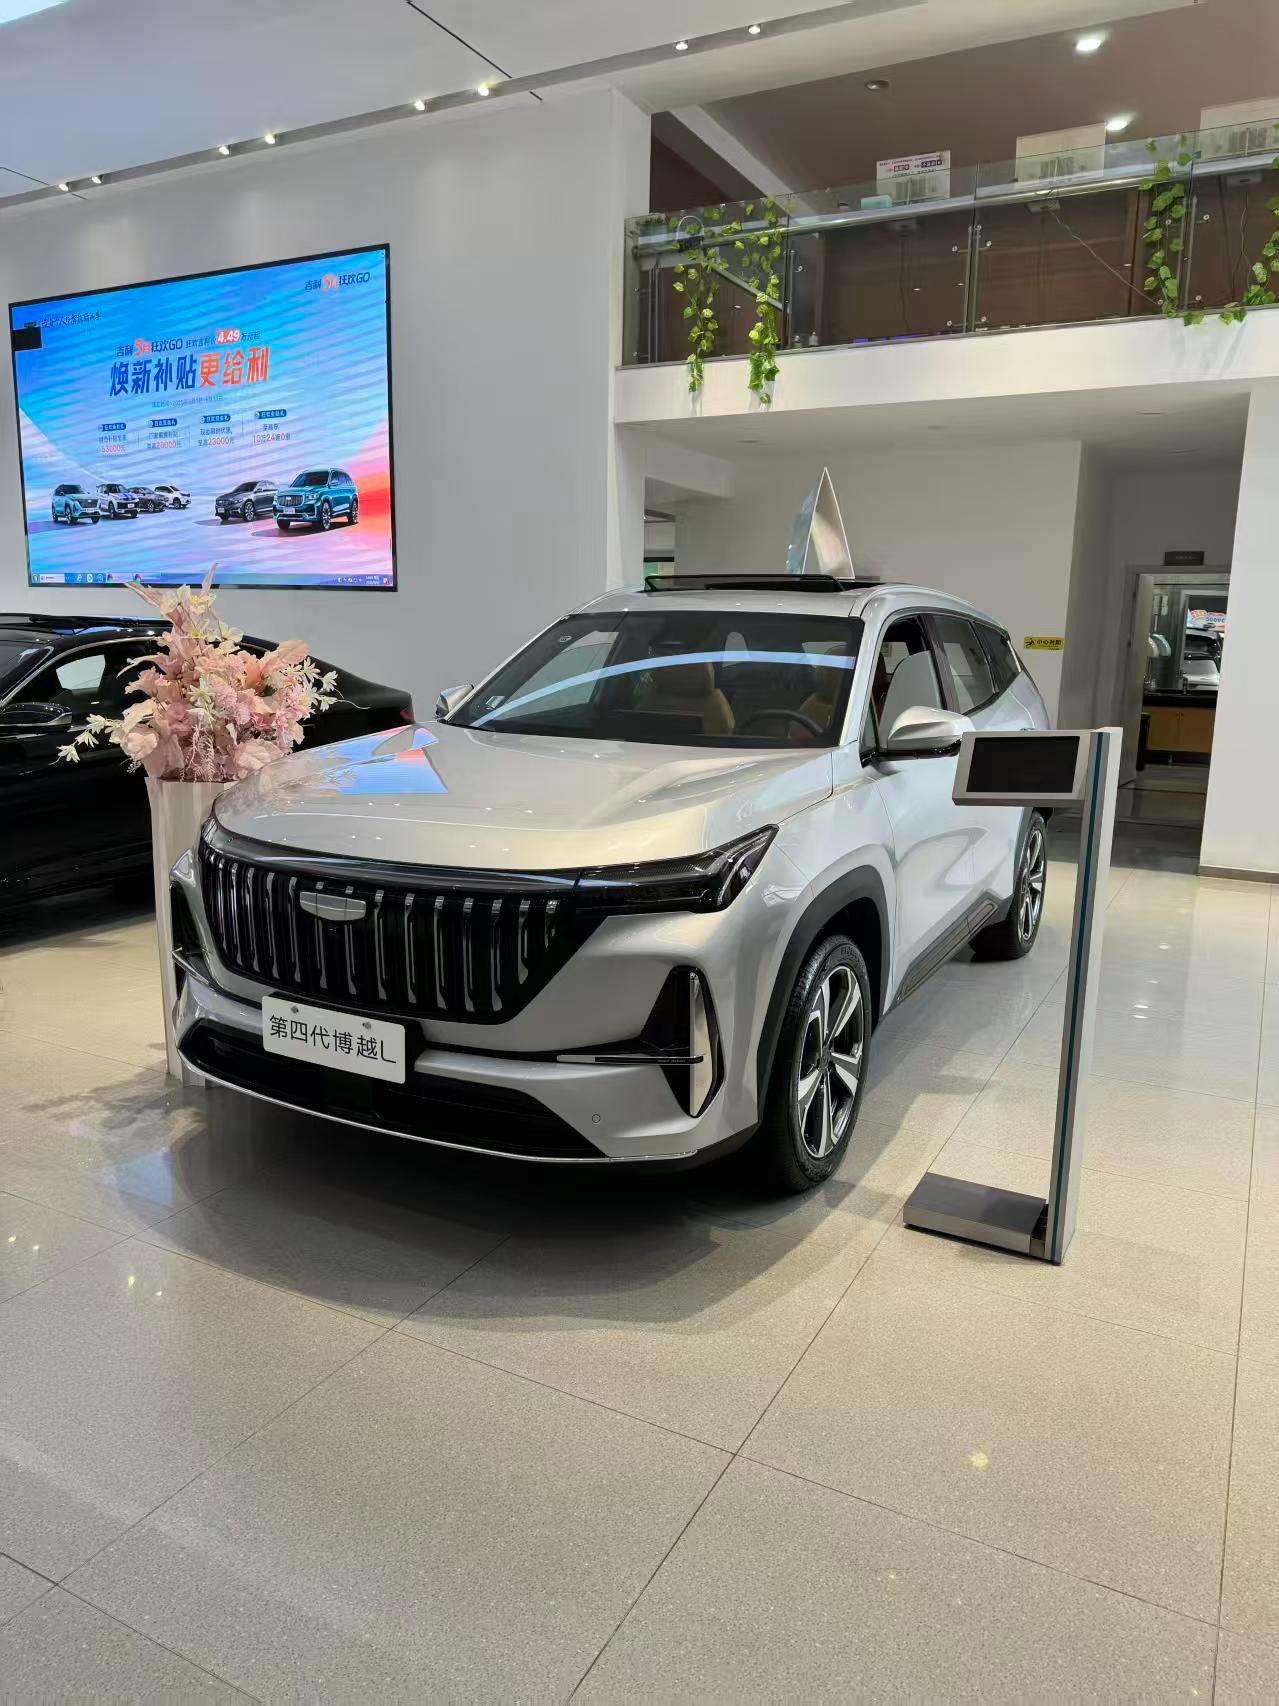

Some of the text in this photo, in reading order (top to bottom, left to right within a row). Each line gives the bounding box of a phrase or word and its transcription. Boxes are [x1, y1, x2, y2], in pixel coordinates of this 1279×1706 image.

[109, 346, 269, 397] 焕新补贴更给利
[116, 338, 183, 357] 吉利5月狂欢GO
[269, 1013, 397, 1064] 第四代博越L
